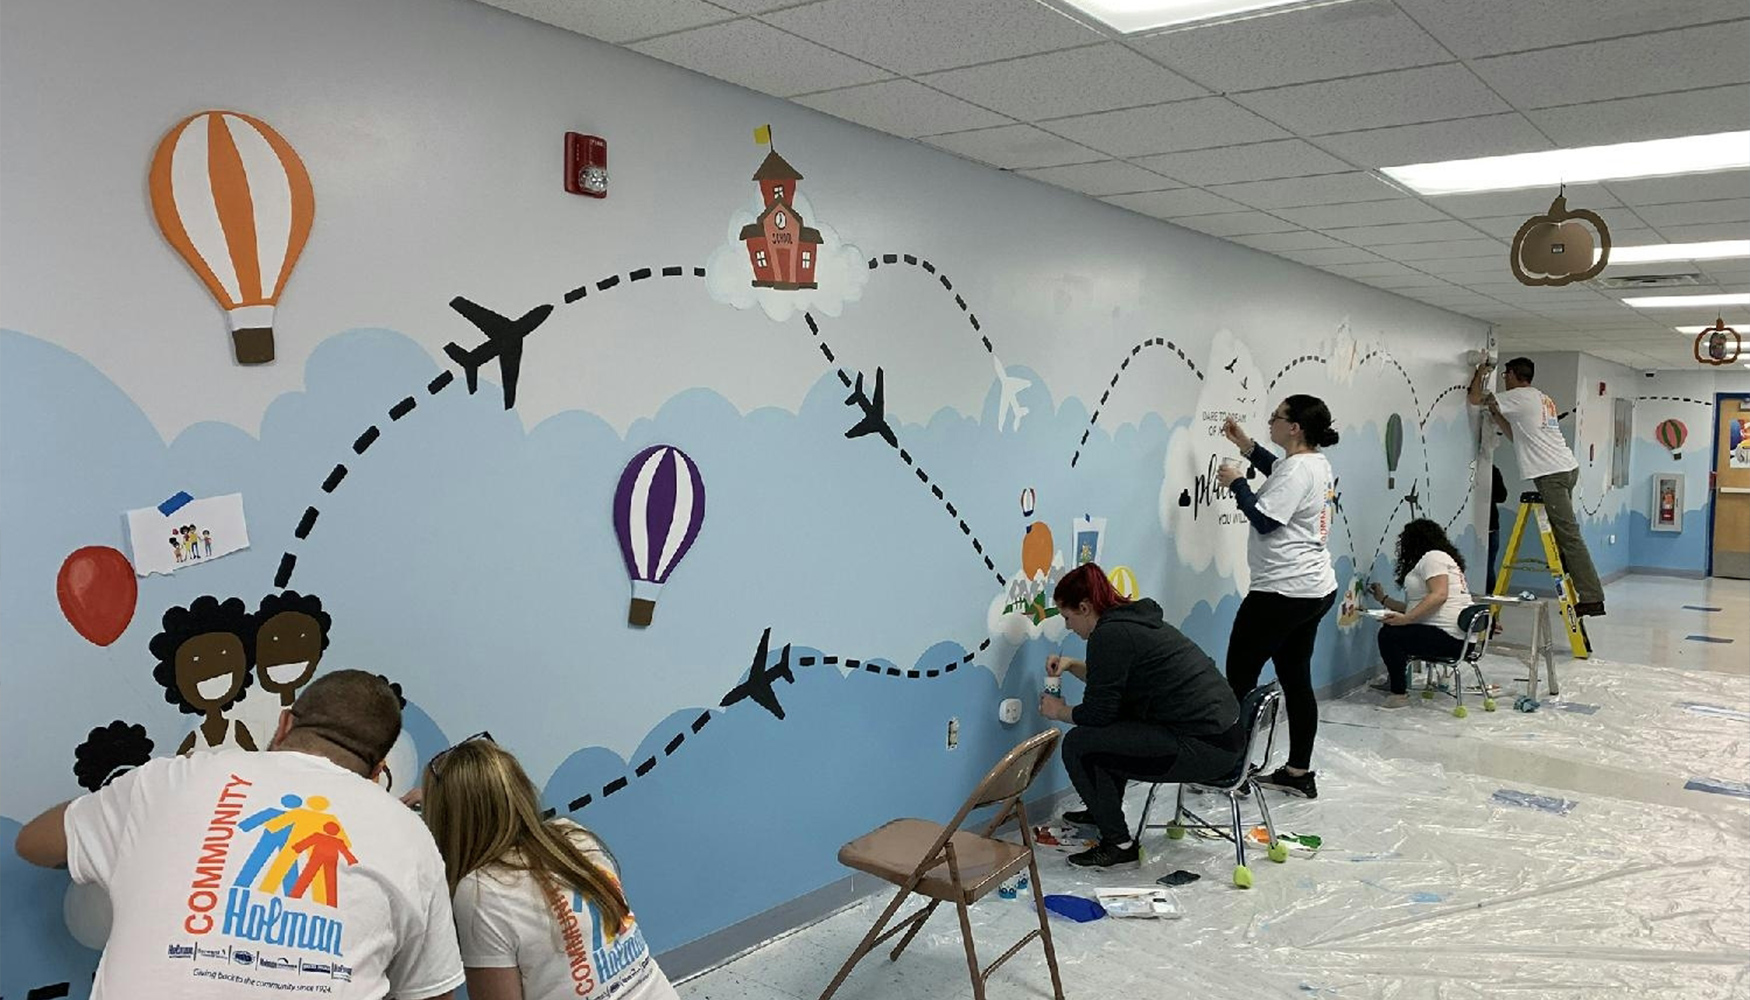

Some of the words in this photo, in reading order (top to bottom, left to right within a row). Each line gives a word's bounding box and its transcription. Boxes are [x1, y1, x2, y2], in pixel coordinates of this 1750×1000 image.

[1202, 411, 1218, 422] DARE
[184, 774, 252, 934] COMMUNITY
[222, 888, 343, 957] Holman
[193, 968, 217, 979] Giving
[217, 971, 235, 982] back
[235, 975, 244, 984] to
[244, 976, 256, 986] the
[256, 979, 296, 993] community
[297, 984, 314, 993] since
